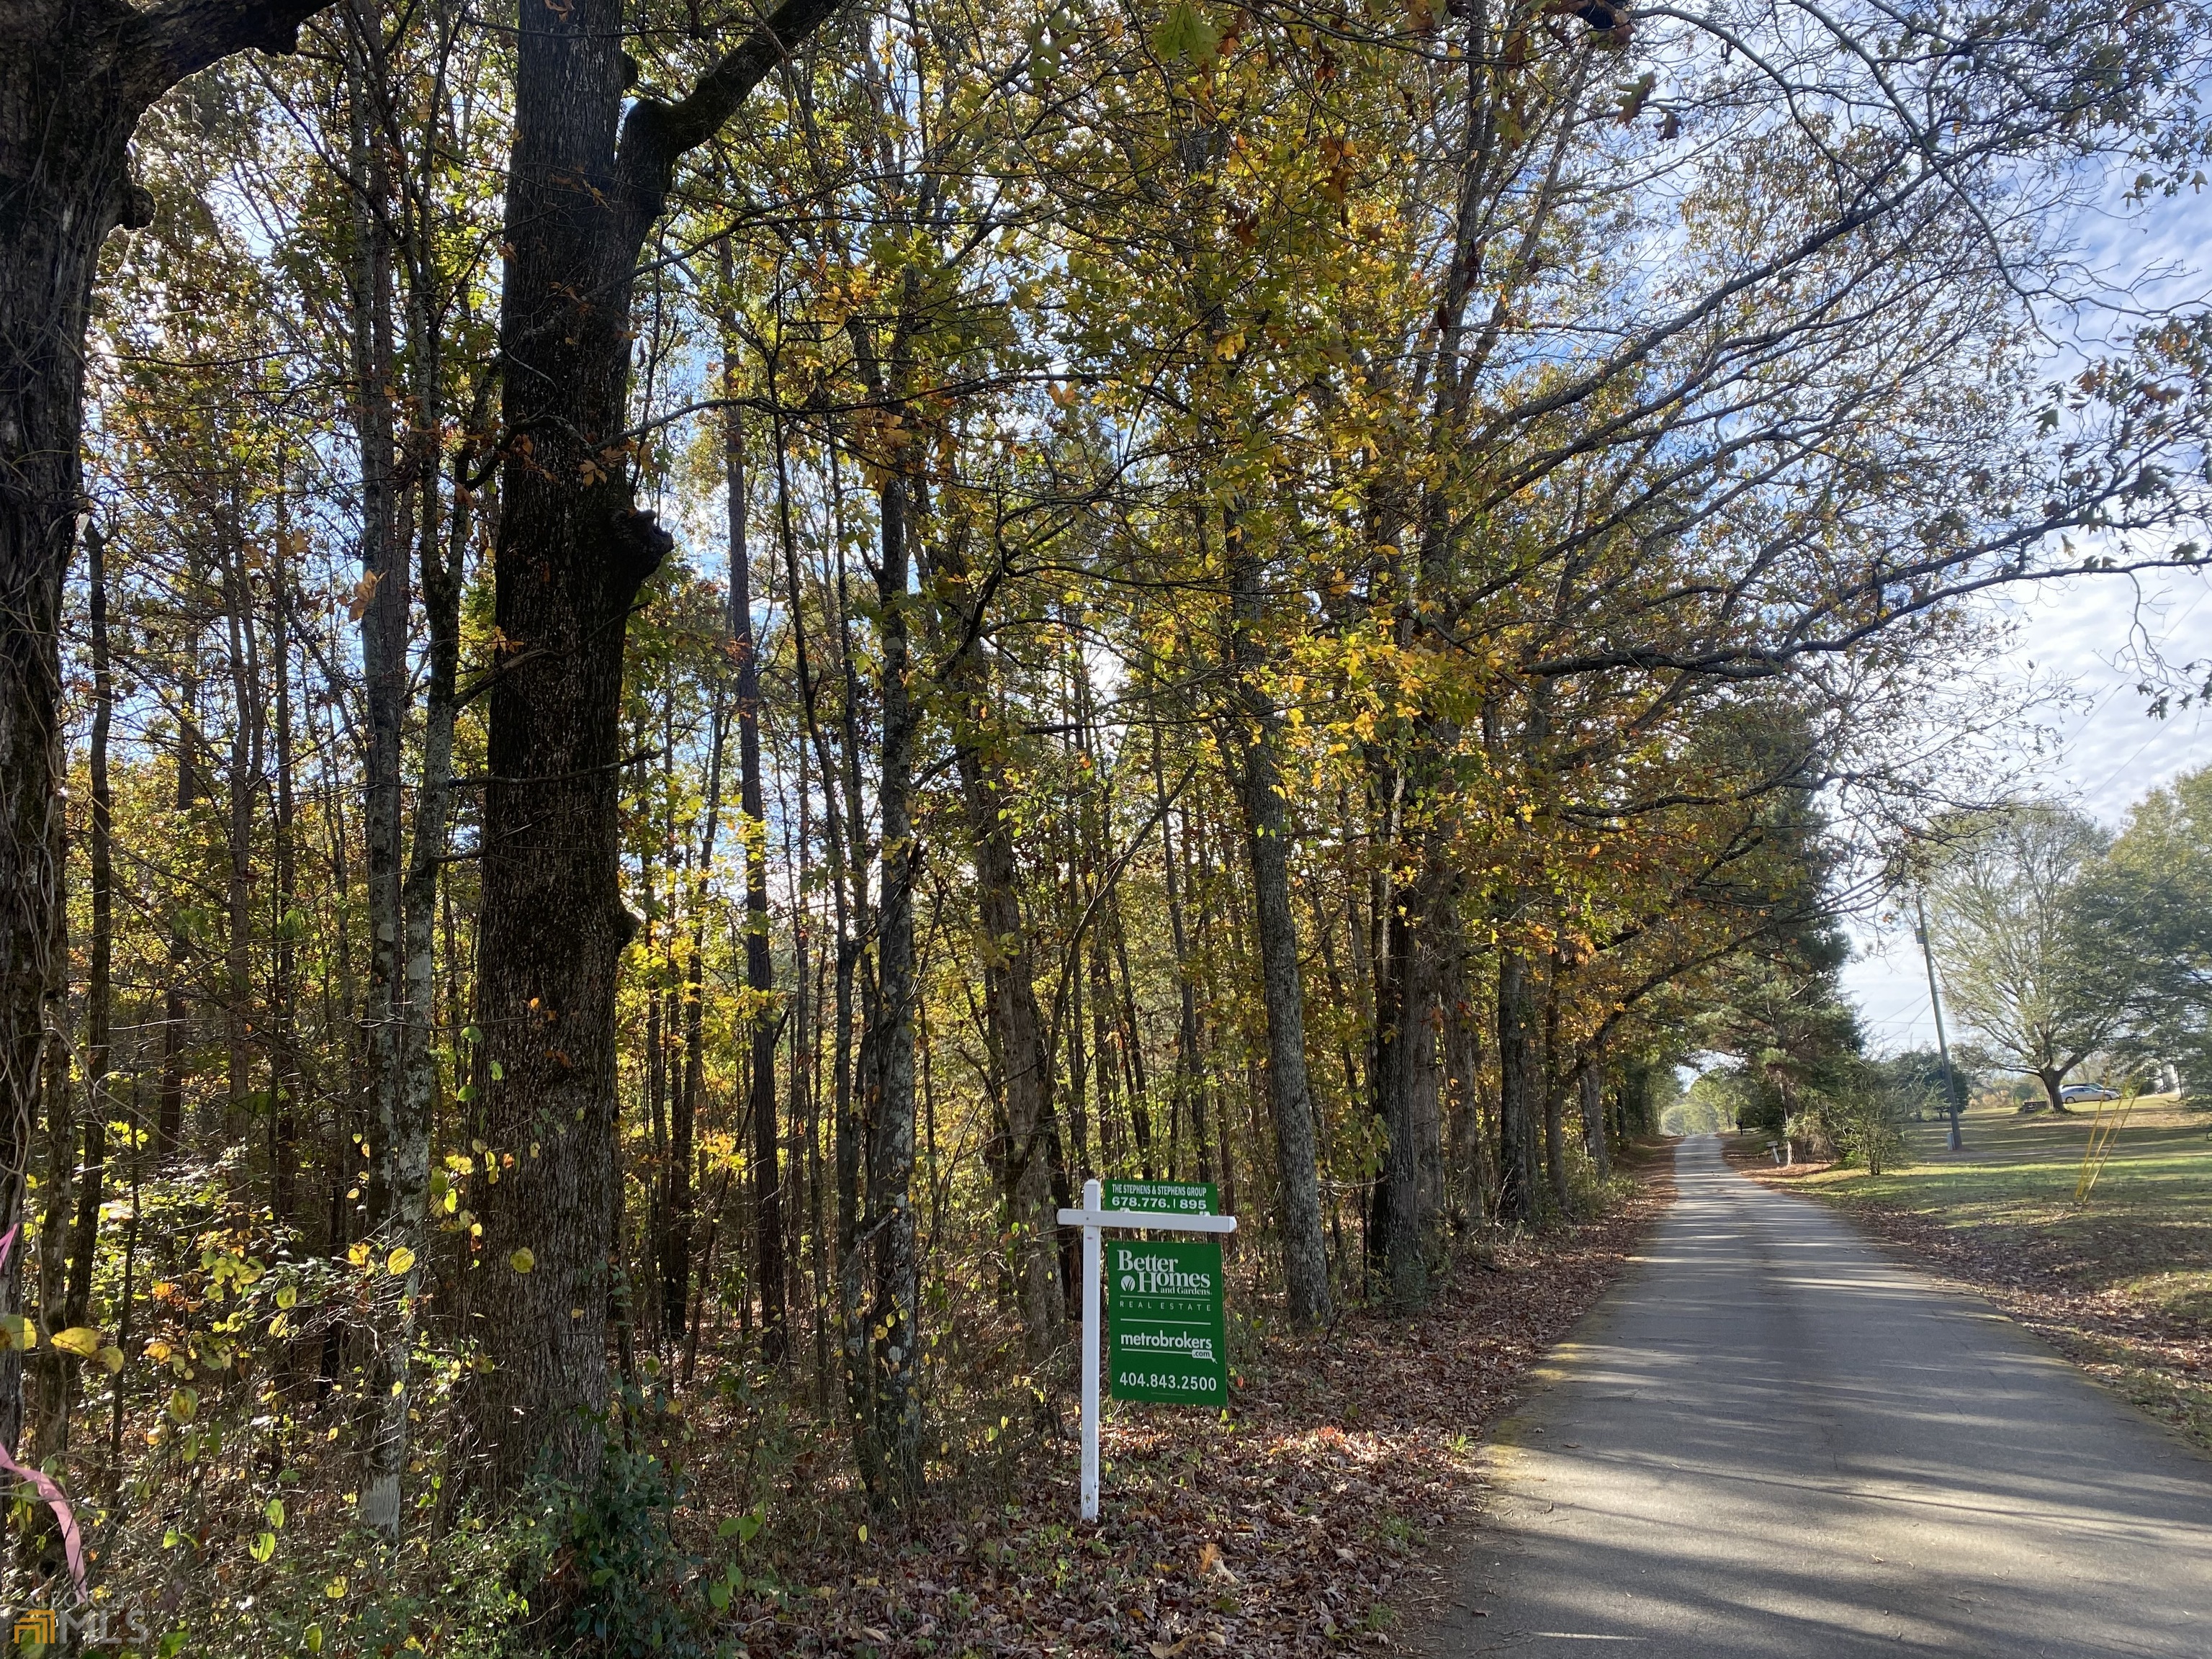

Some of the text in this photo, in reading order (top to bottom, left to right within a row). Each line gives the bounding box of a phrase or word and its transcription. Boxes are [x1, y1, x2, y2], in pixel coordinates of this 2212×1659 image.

[1112, 1183, 1207, 1197] THE STEPHENS & STEPHENS GROUP
[1117, 1249, 1179, 1273] Better
[1137, 1271, 1211, 1293] Homes
[1177, 1287, 1210, 1295] Gardens
[1120, 1300, 1211, 1312] REAL ESTATE
[1120, 1330, 1213, 1349] metrobrokers
[1120, 1372, 1217, 1391] 404.843.2500
